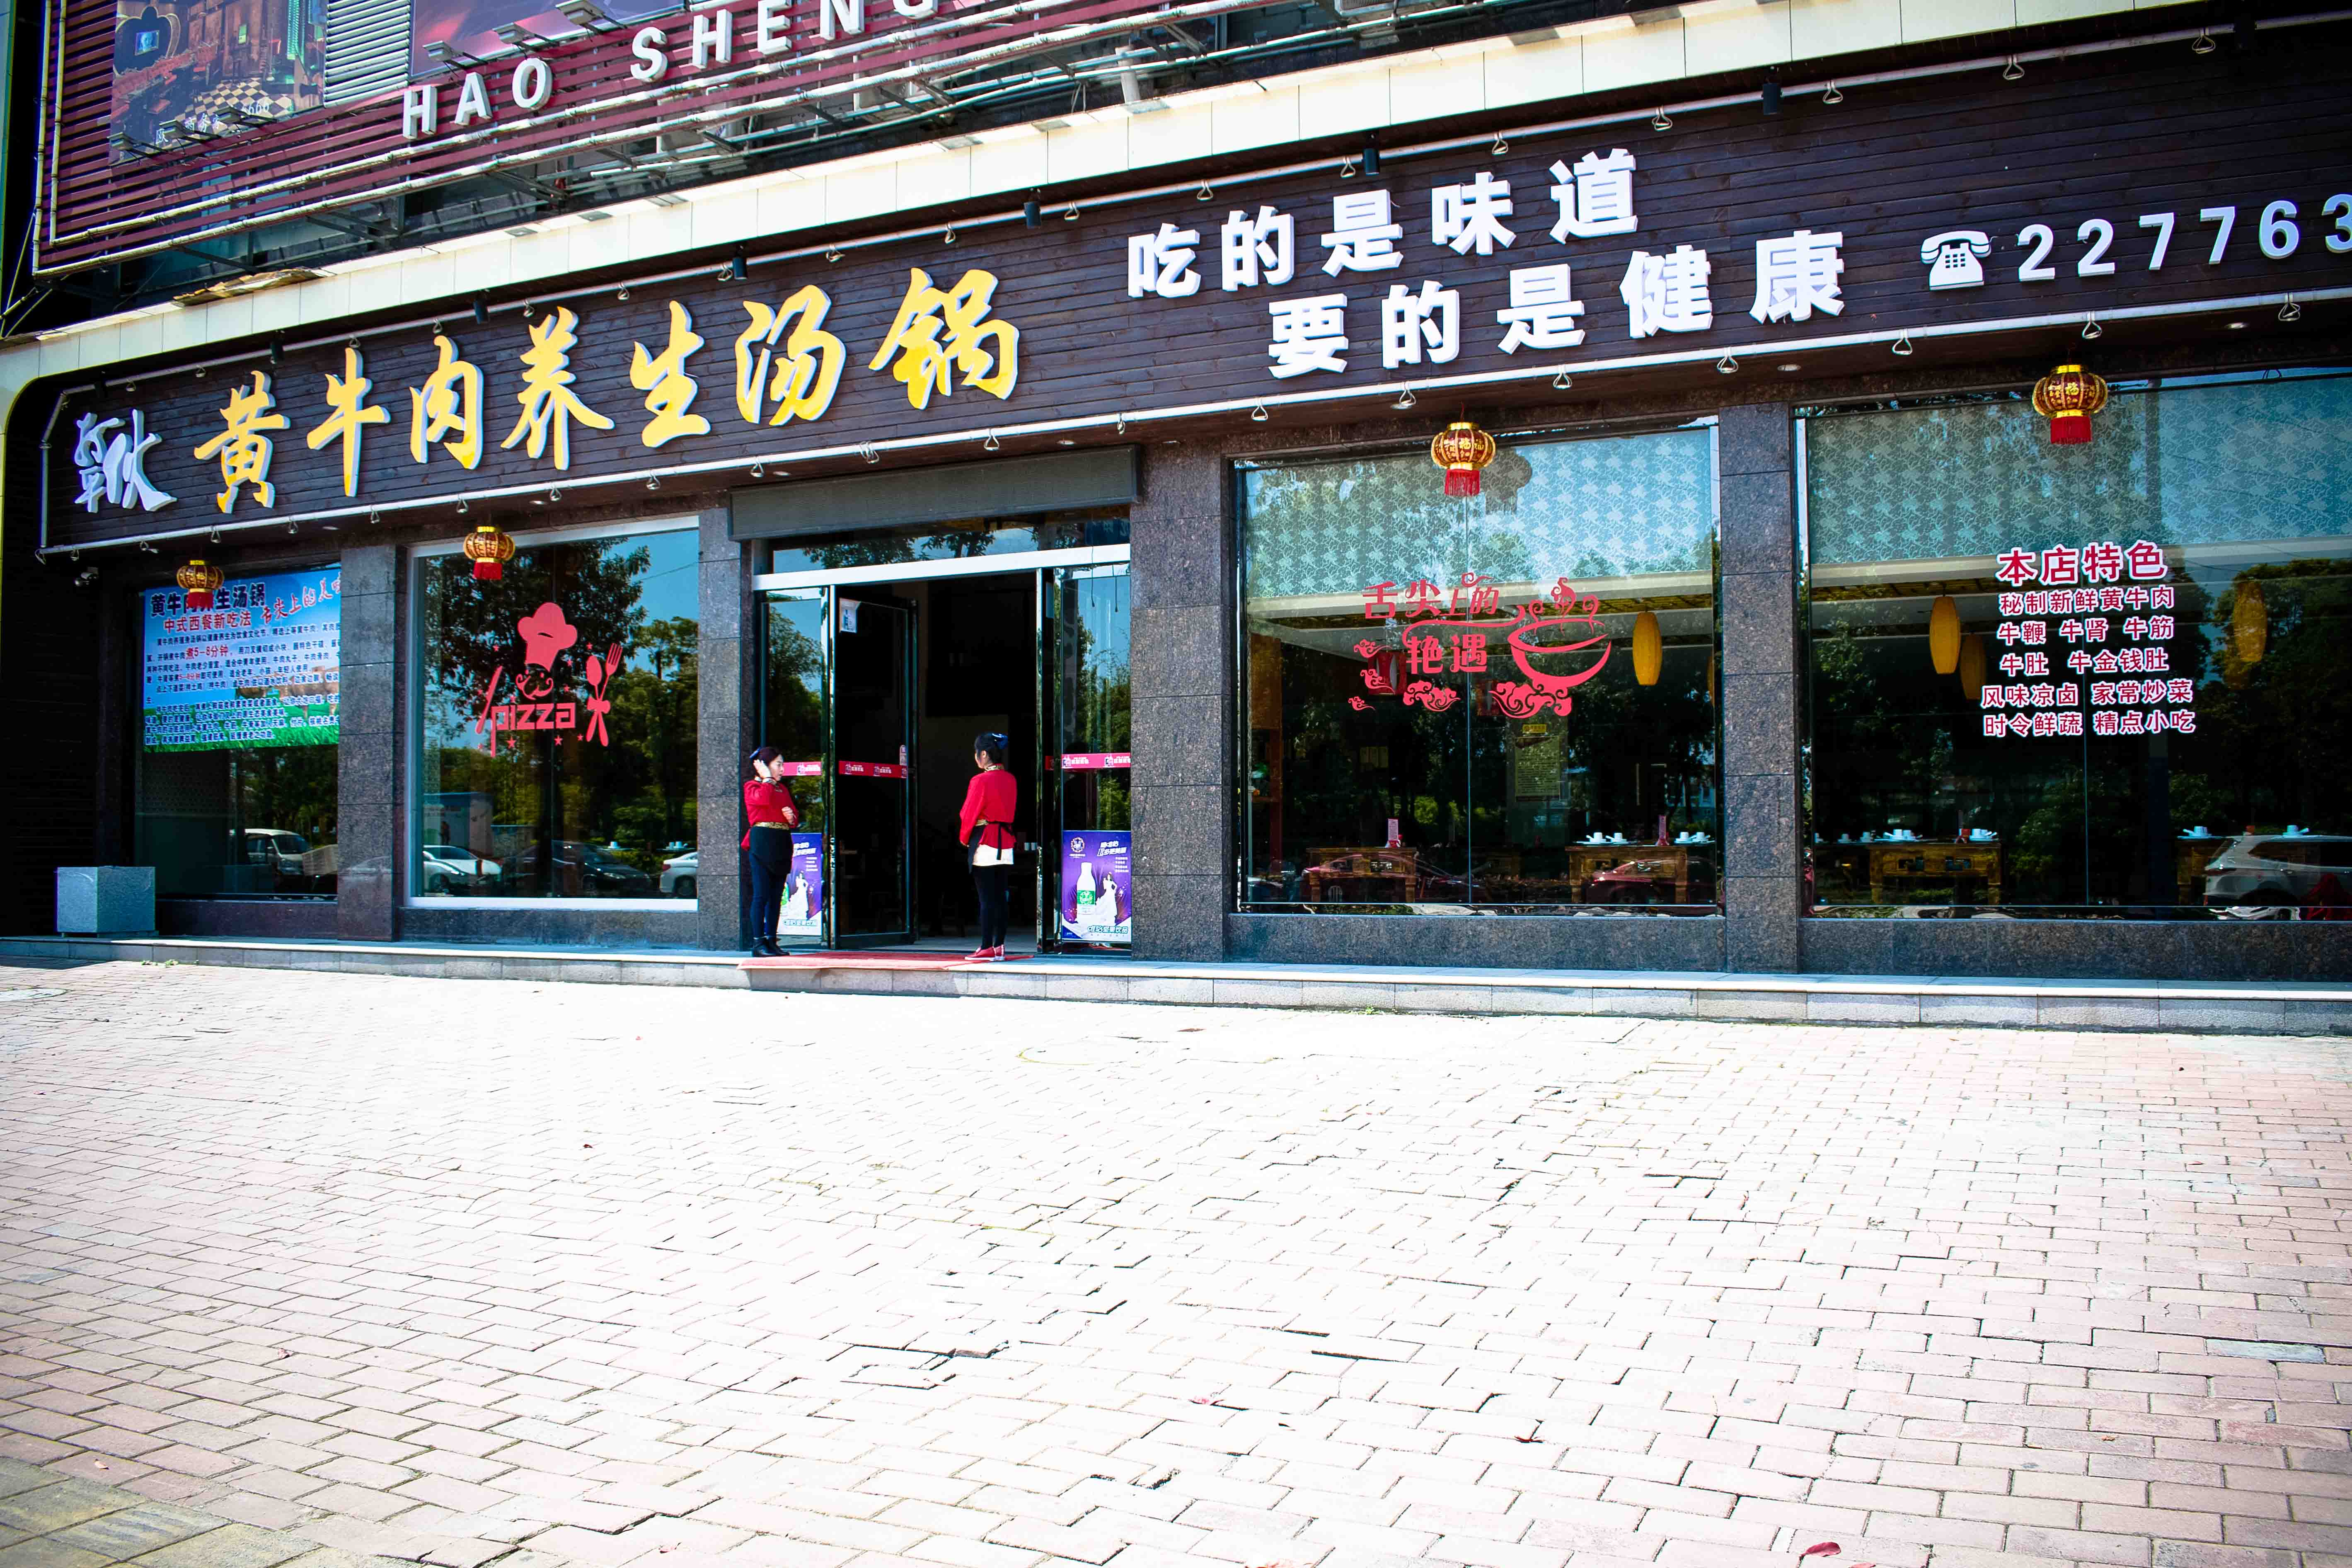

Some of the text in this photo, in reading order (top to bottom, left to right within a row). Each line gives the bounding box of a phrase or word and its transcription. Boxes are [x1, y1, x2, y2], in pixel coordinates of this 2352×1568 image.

[403, 58, 552, 139] HAO
[1128, 148, 1638, 298] 吃的是味道
[2017, 194, 2352, 282] 227763
[1268, 230, 1844, 379] 要的是健康
[194, 266, 1020, 514] 黄牛肉养生汤锅
[1996, 540, 2168, 587] 本店特色
[150, 583, 266, 617] 黄牛生汤锅
[1362, 578, 1499, 619] 舌尖上的
[1999, 586, 2175, 616] 秘制新鲜黄牛肉
[164, 610, 252, 634] 中式西餐新吃法
[1997, 615, 2175, 645] 牛鞭 牛肾 牛筋
[1406, 634, 1488, 674] 艳遇
[2000, 647, 2170, 676] 牛肚 牛金钱肚
[1981, 678, 2194, 708] 风味凉卤 家常炒菜
[491, 700, 576, 757] pizza
[1983, 709, 2196, 737] 时令鲜蔬 精点小吃
